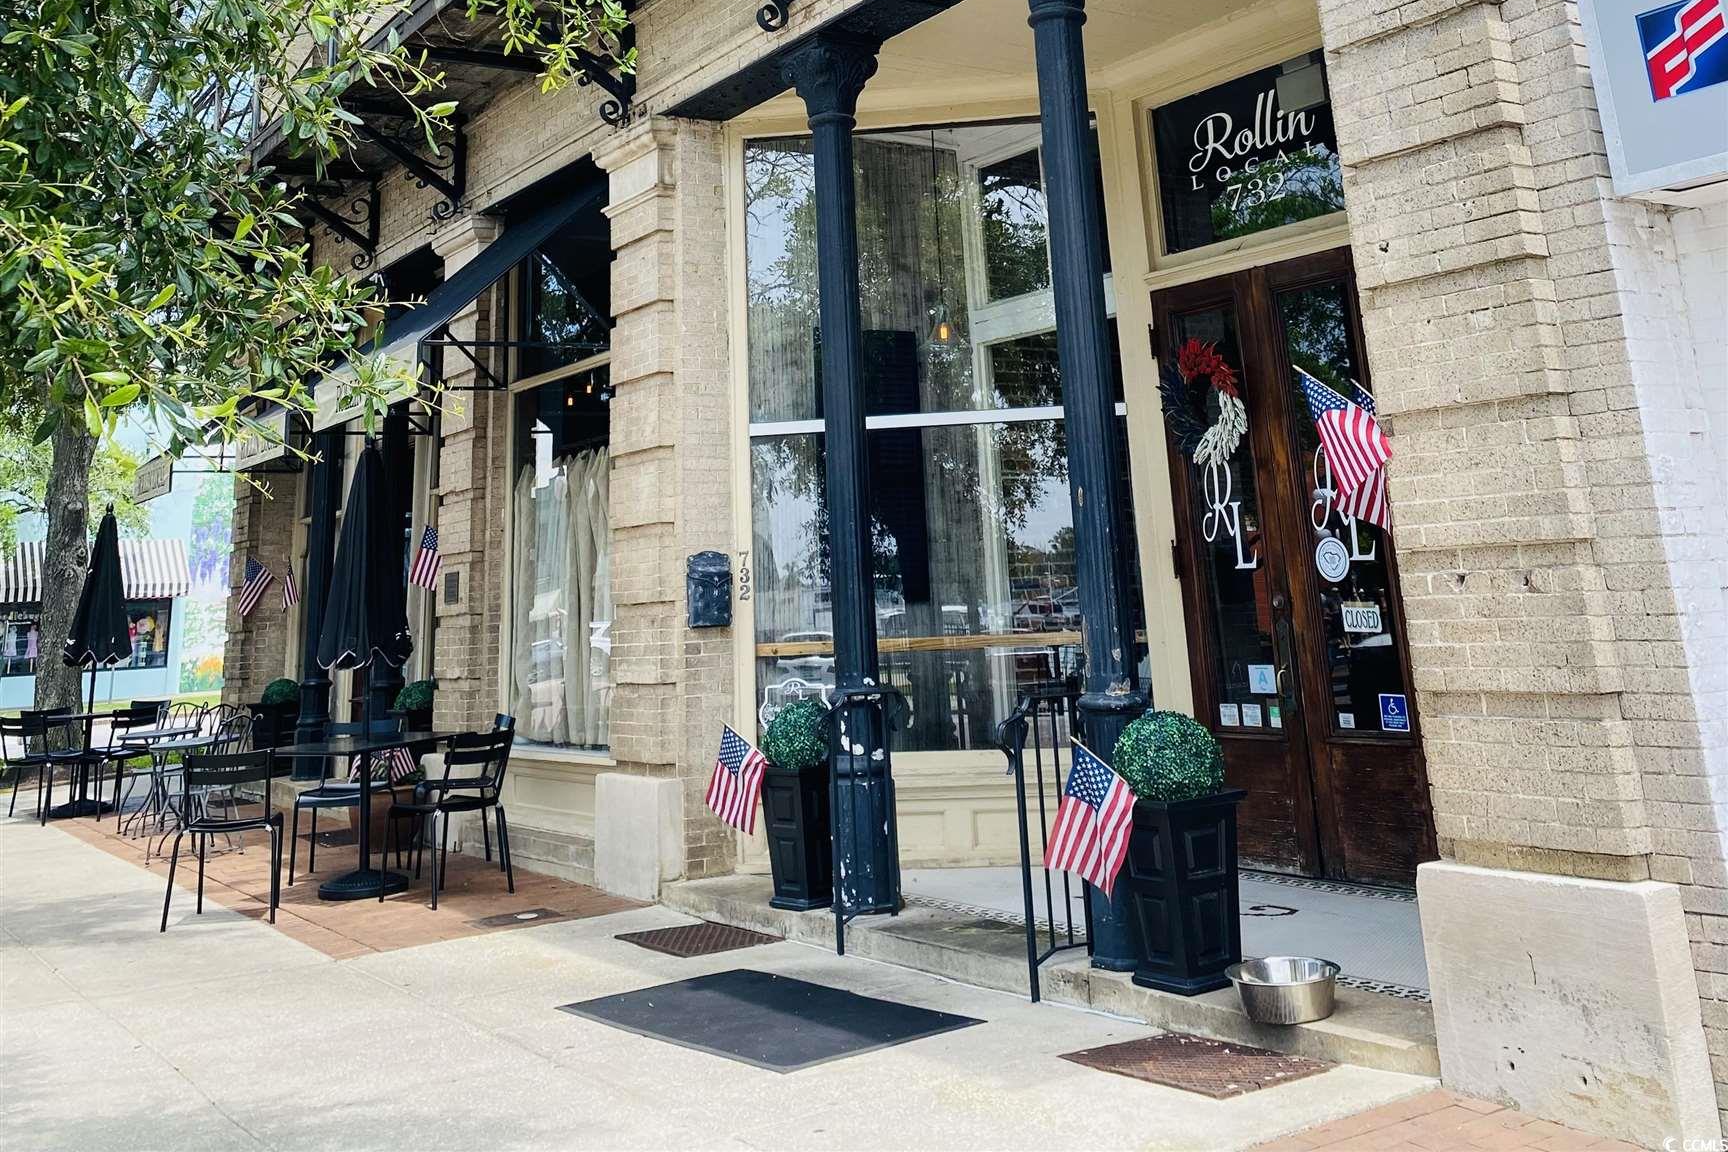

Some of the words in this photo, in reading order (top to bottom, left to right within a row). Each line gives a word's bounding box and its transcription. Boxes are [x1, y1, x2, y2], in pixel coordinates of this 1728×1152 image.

[1189, 89, 1315, 172] Rollin
[1192, 141, 1318, 190] LOCAL
[1226, 172, 1286, 211] 732
[738, 550, 751, 601] 732
[1345, 609, 1379, 629] CLOSED
